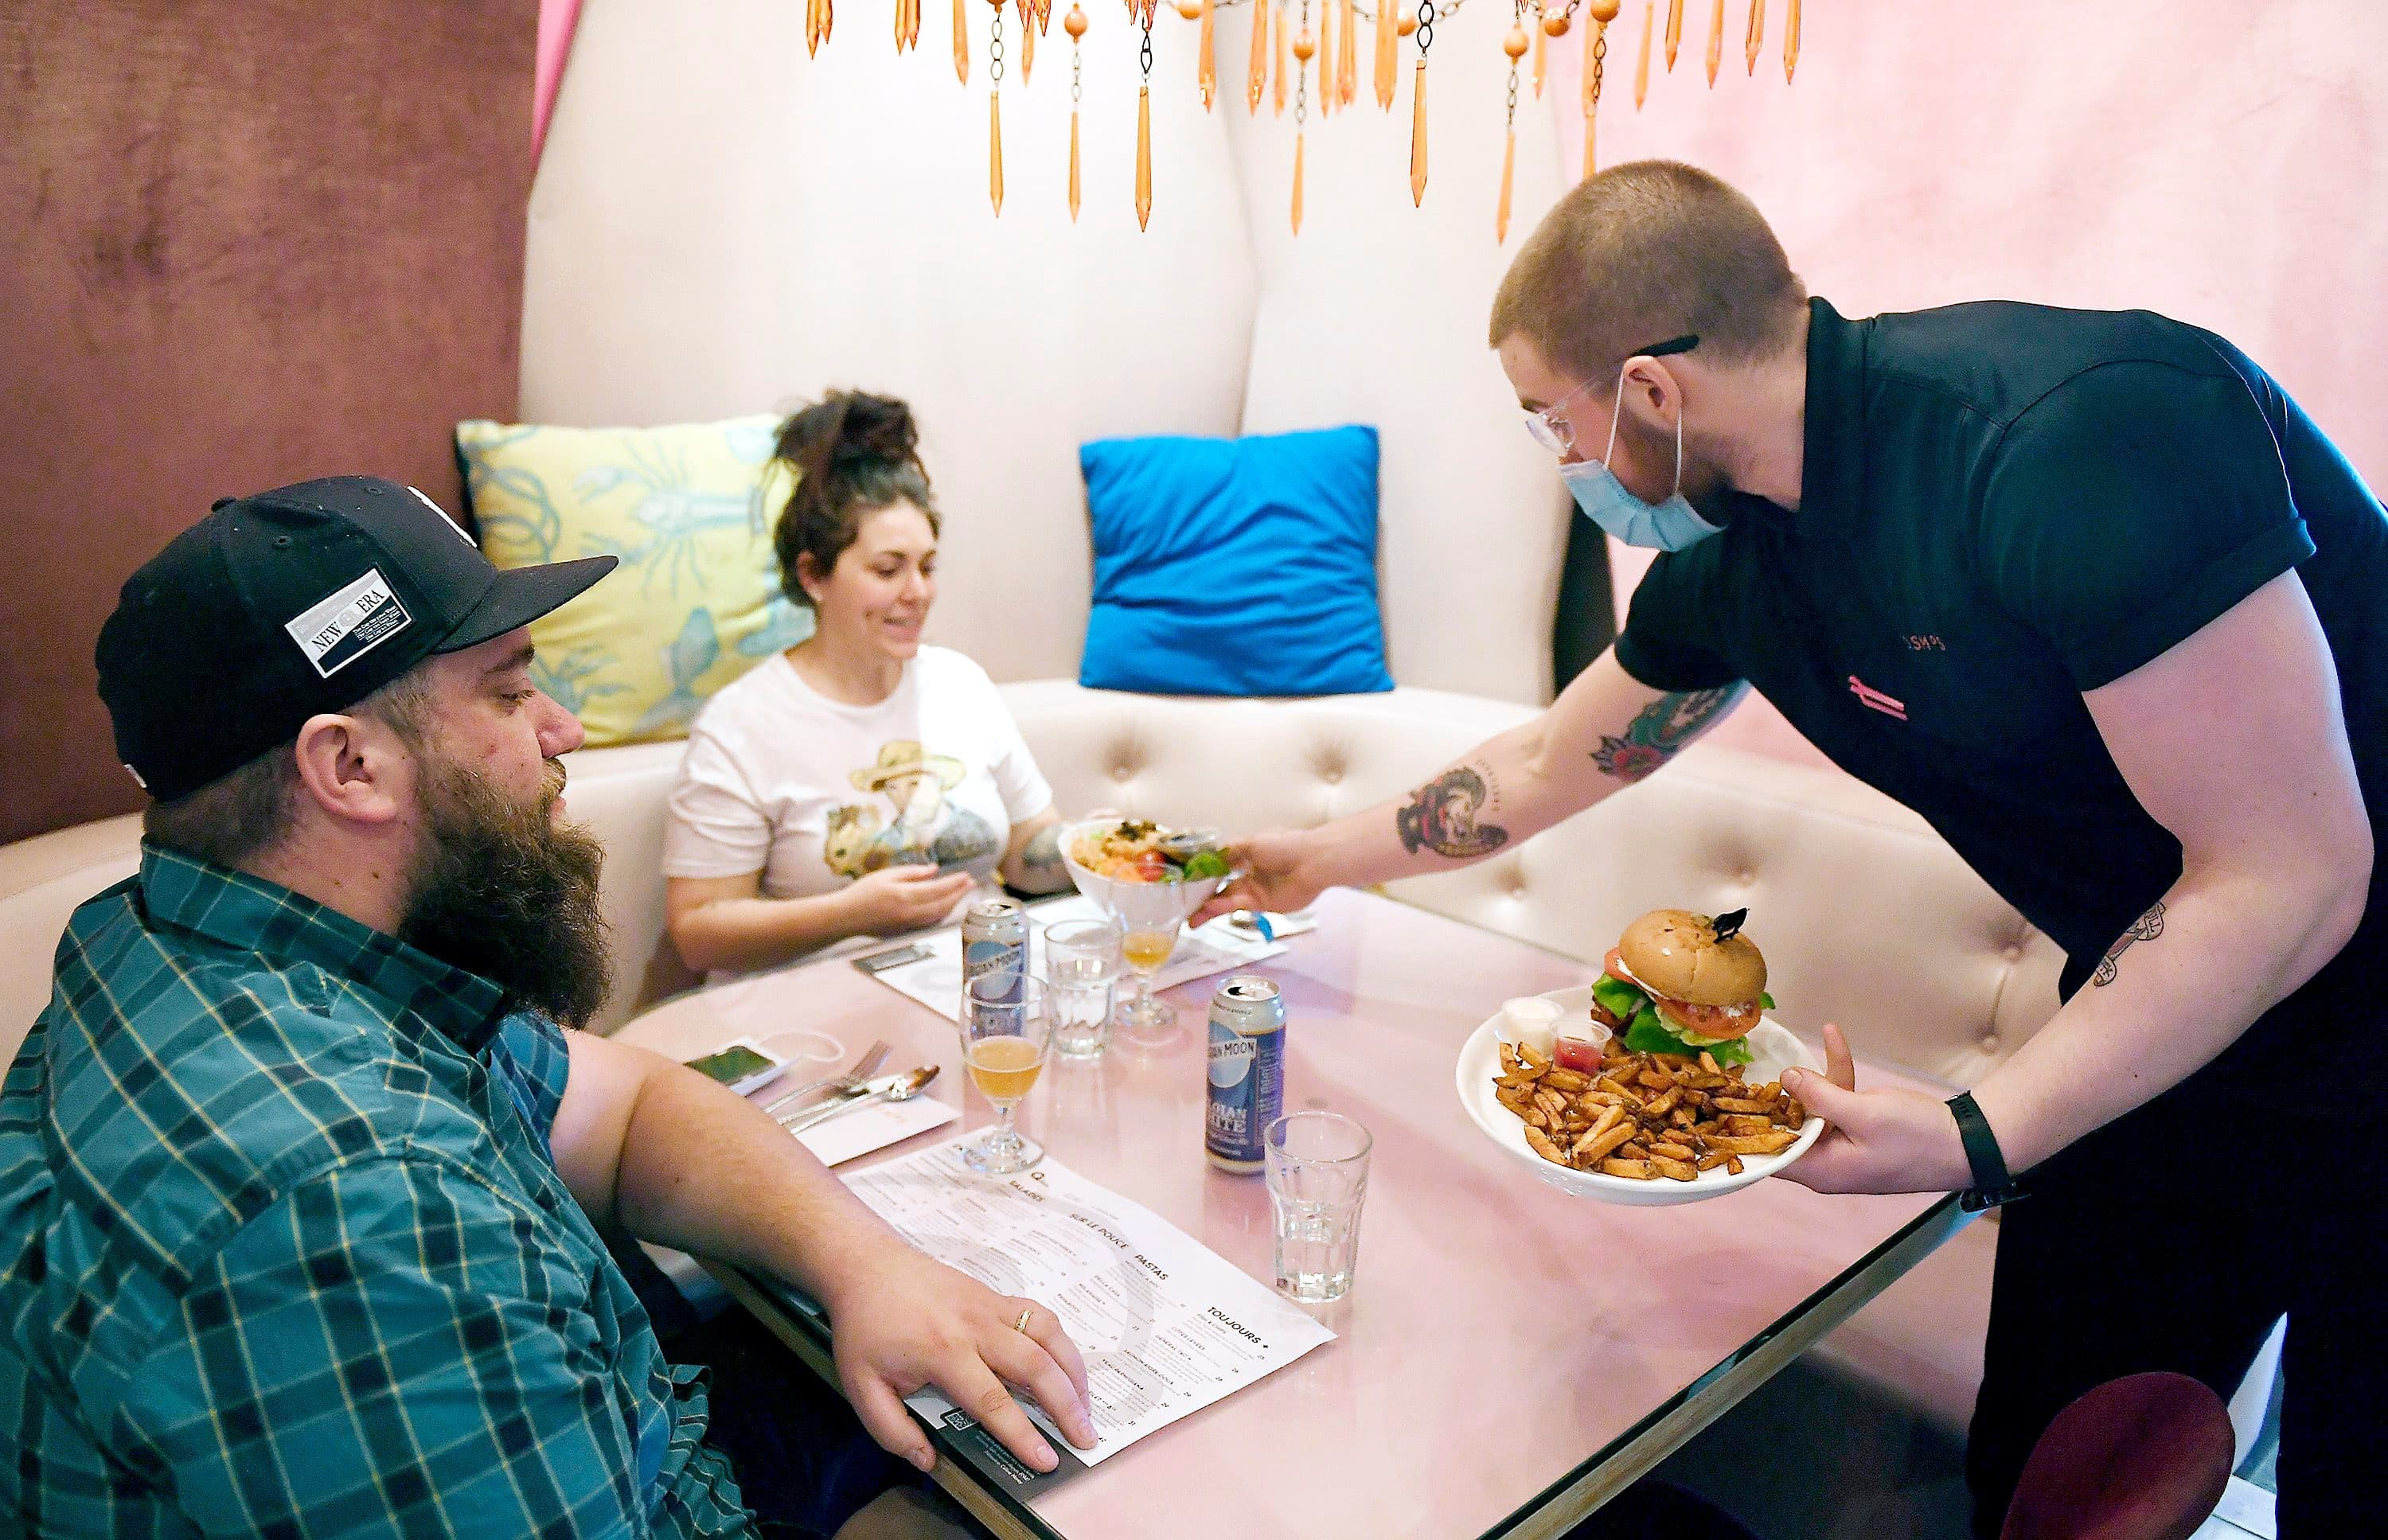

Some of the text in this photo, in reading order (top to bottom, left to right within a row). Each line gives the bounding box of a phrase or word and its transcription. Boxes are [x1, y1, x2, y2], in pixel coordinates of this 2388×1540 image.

[311, 589, 385, 653] NEW ERA
[1224, 1042, 1254, 1056] MOON
[1069, 1213, 1088, 1223] SUR
[1098, 1228, 1130, 1250] POUCE
[1134, 1254, 1169, 1281] PASTAS
[1207, 1306, 1261, 1344] TOUJOURS
